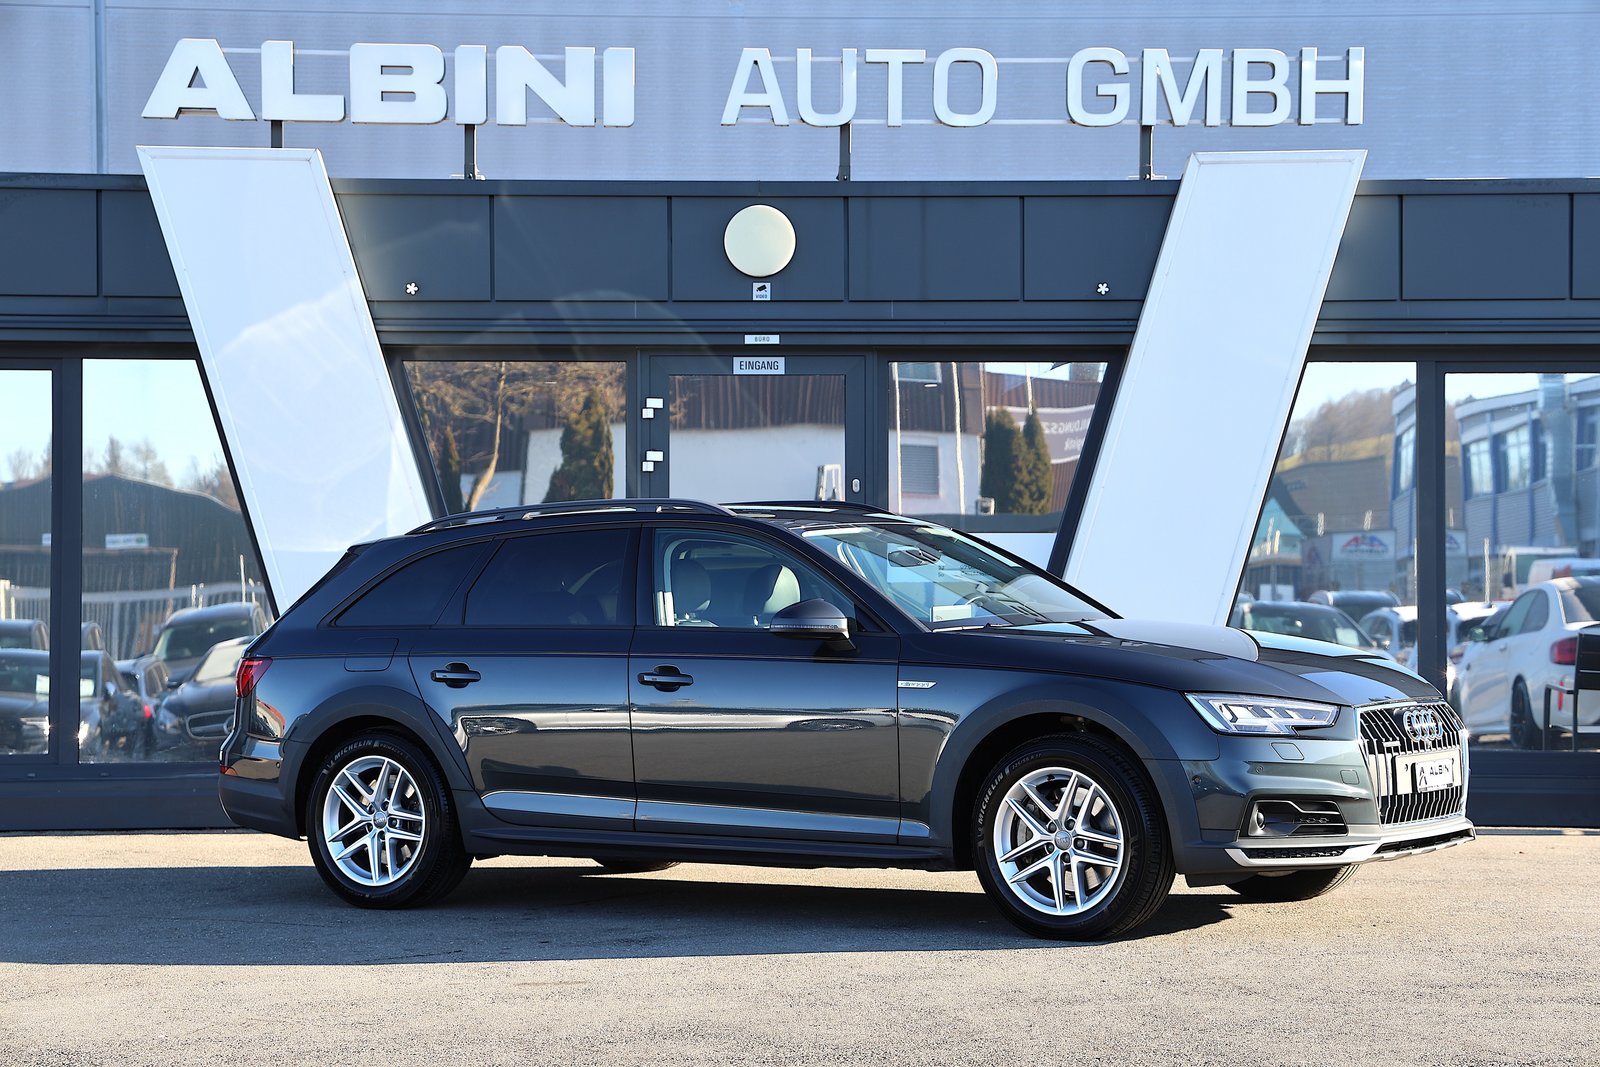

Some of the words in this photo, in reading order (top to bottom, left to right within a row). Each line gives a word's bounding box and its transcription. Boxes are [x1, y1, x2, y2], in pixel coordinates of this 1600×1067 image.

[141, 38, 636, 127] ALBINI
[721, 47, 999, 127] AUTO
[1066, 46, 1365, 127] GMBH
[739, 360, 779, 371] EINGANG
[334, 740, 373, 761] MICHELIN
[978, 772, 1004, 825] MICHELIN
